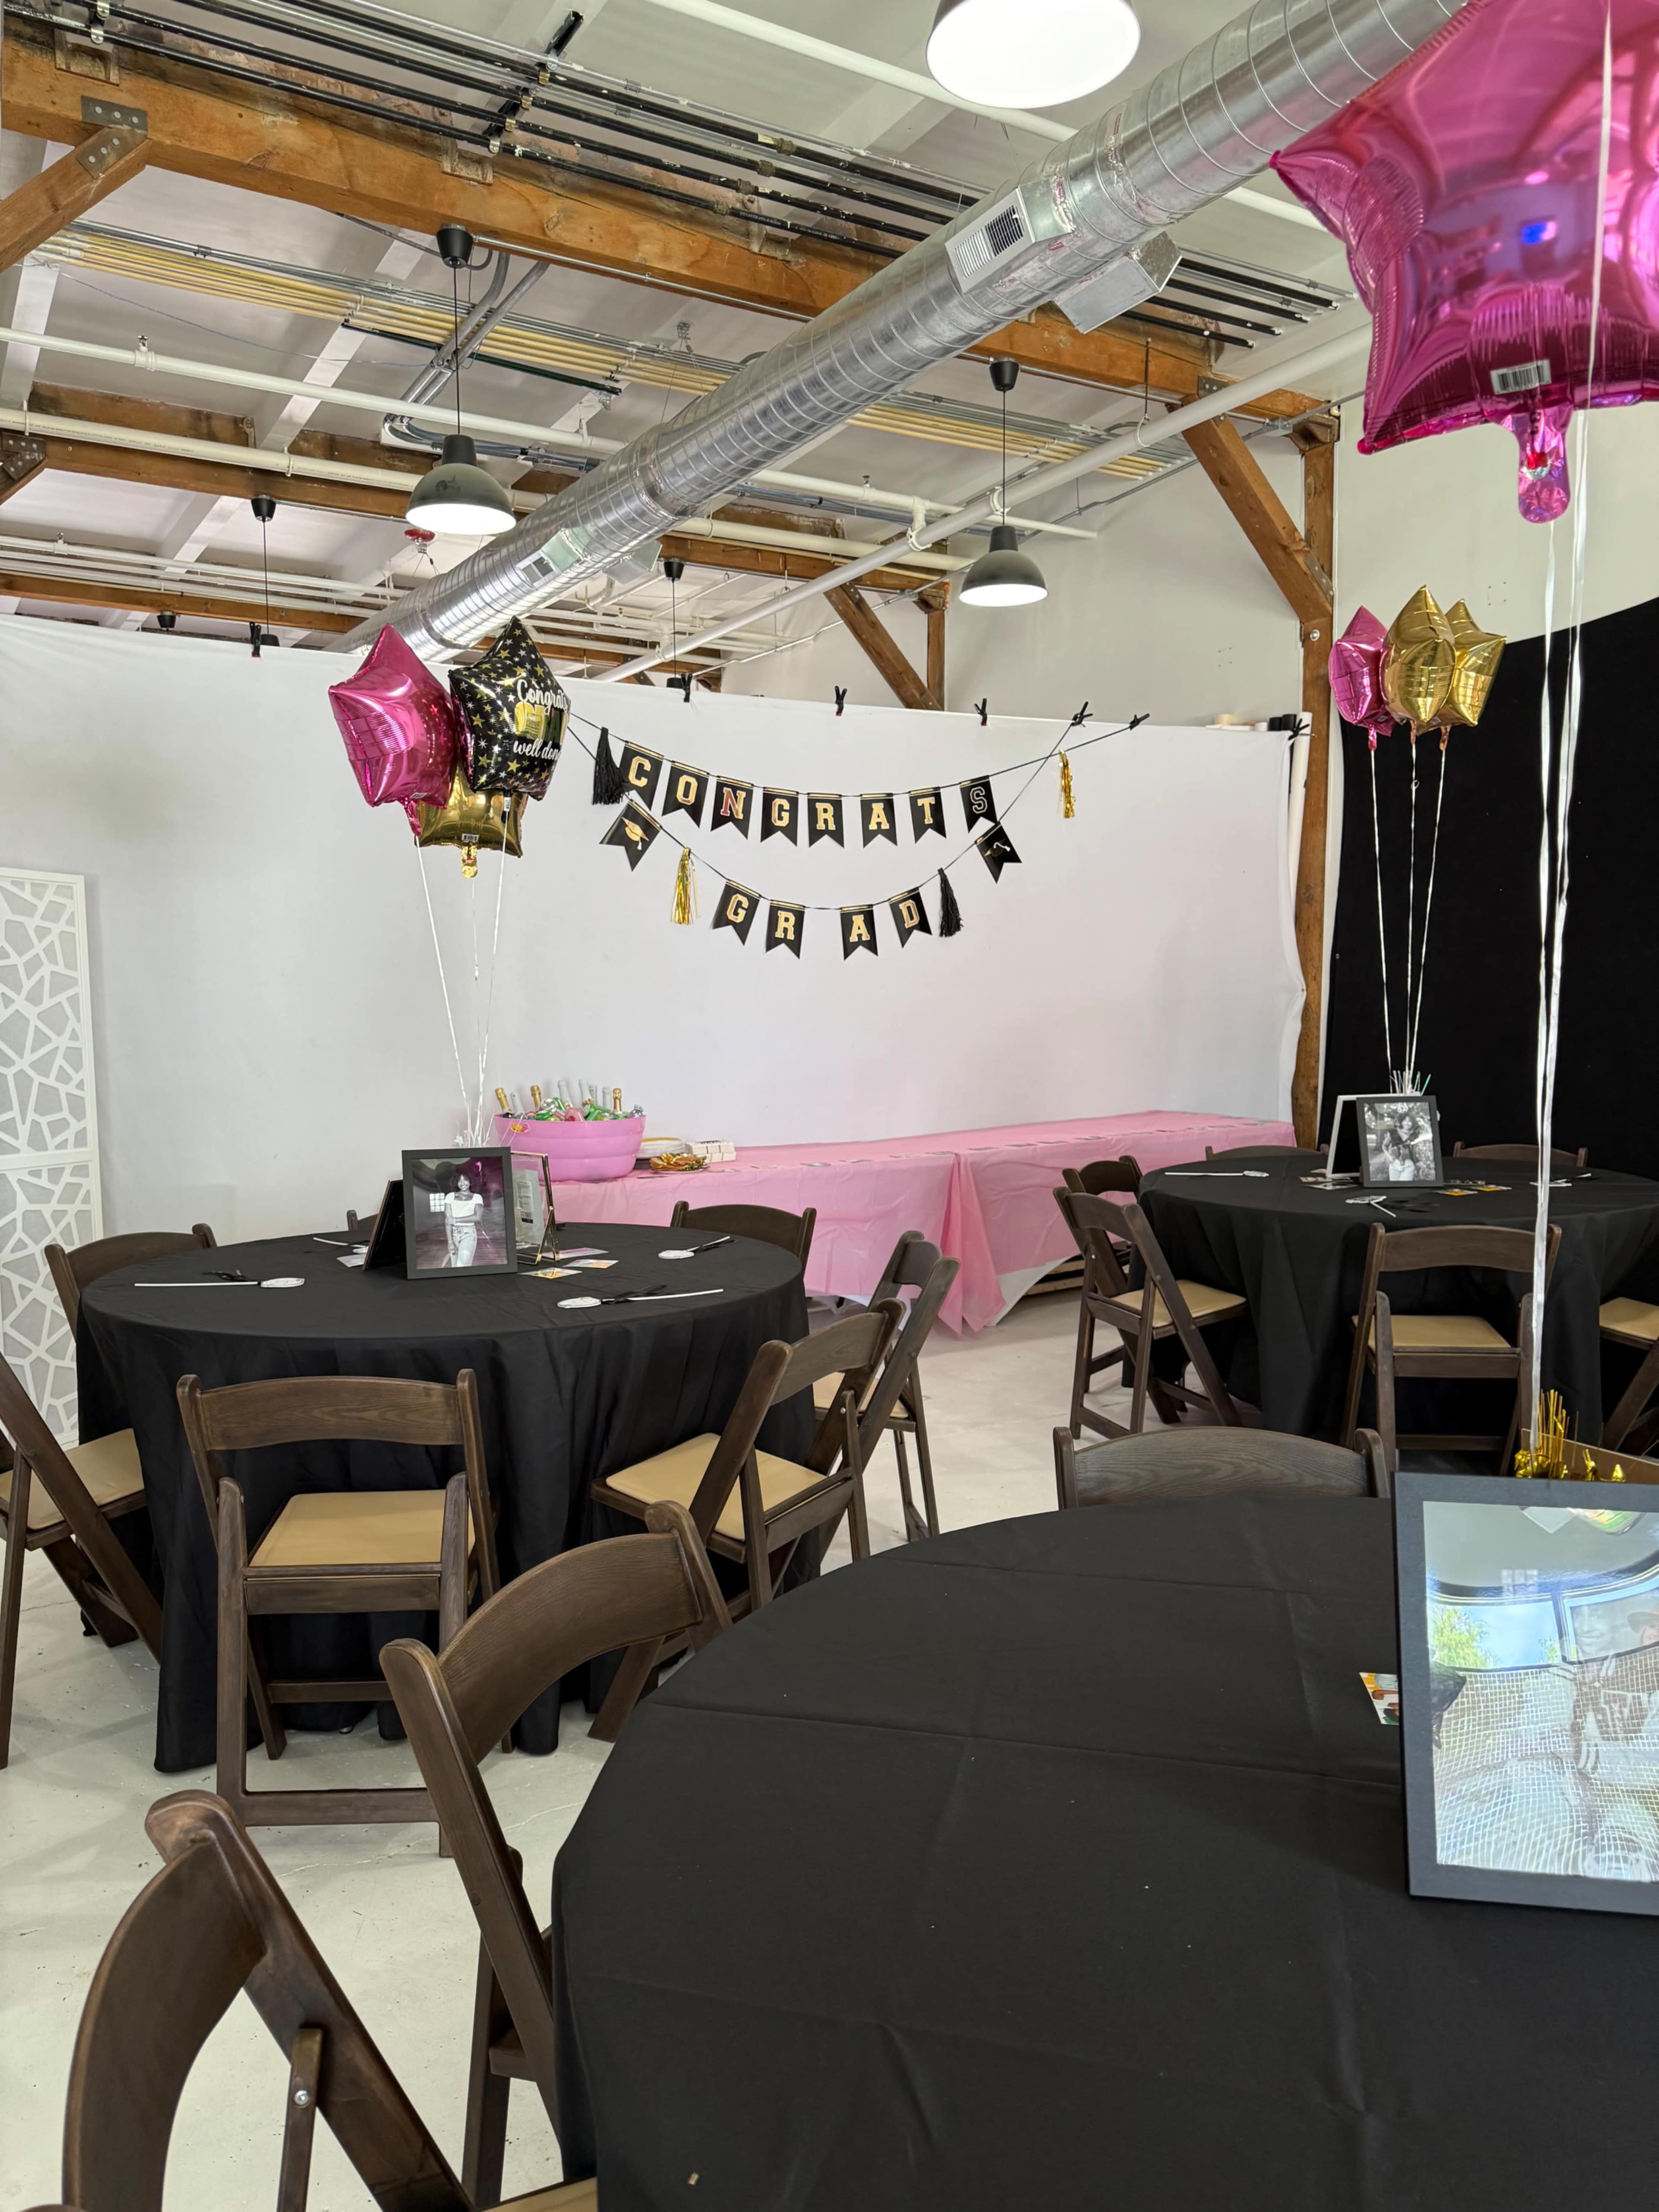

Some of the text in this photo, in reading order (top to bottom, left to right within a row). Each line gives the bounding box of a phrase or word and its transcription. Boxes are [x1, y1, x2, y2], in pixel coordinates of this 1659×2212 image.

[517, 679, 568, 717] Congrats
[513, 738, 562, 761] well don
[628, 756, 987, 830] CONGRATS
[726, 893, 920, 942] GRAD
